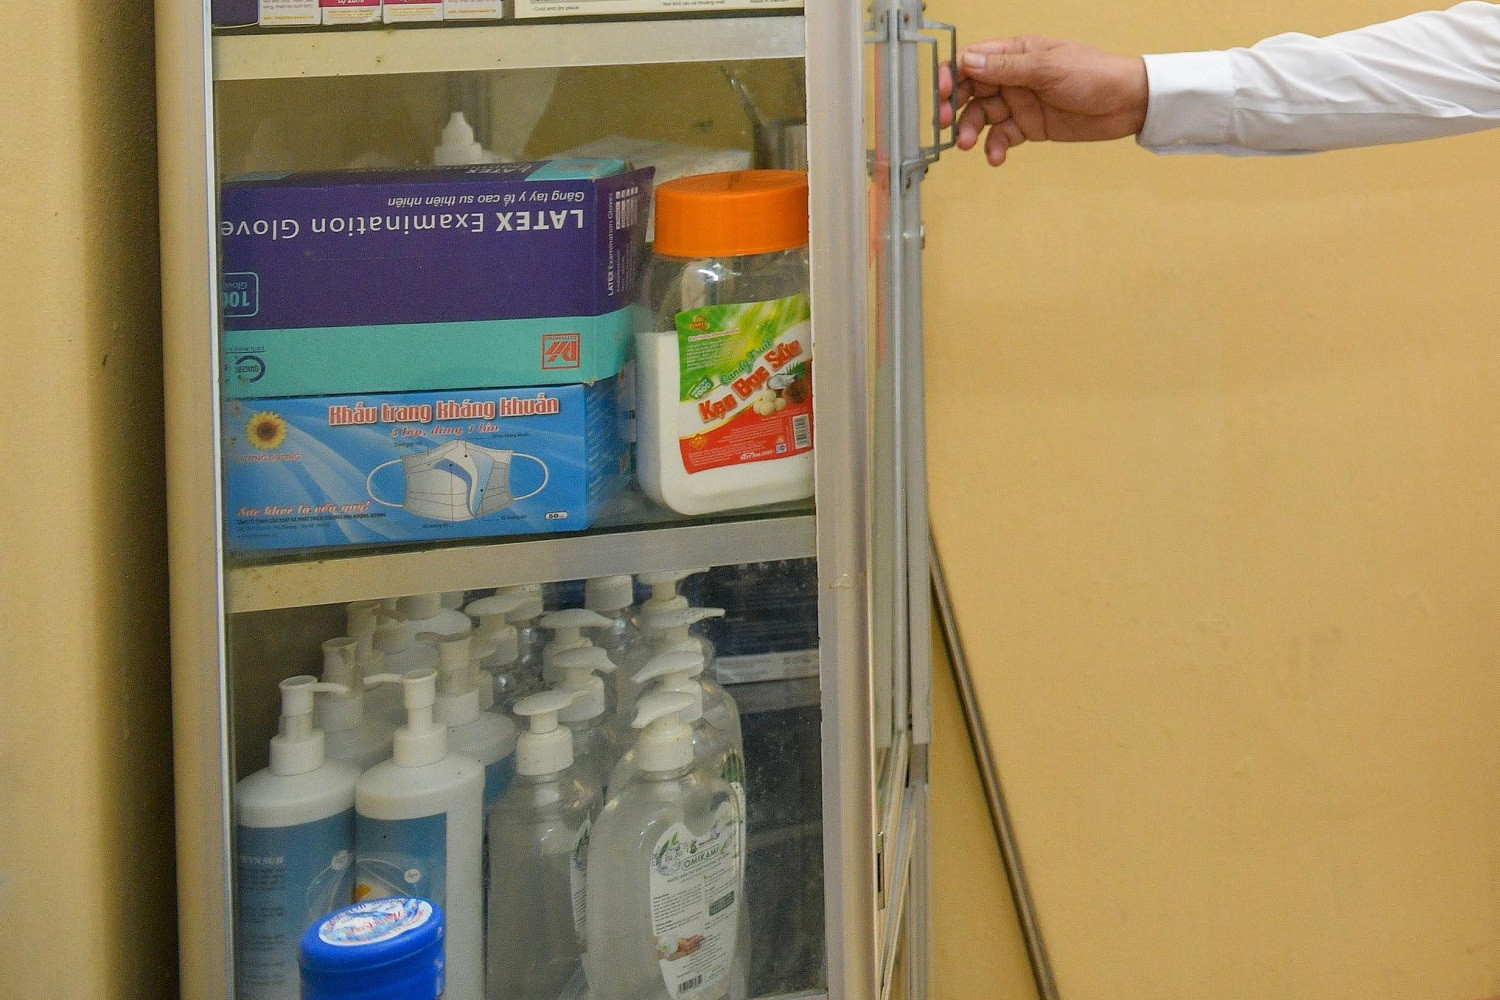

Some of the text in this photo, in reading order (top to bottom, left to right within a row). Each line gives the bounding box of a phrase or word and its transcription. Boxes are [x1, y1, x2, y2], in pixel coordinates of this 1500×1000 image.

[387, 190, 585, 208] Găng tay y tế cao su thiên nhiên
[311, 211, 484, 239] Examination
[496, 209, 584, 231] LATEX
[720, 339, 772, 386] Candy Fruit
[329, 393, 560, 426] Khẩu trang kháng khuẩn
[683, 847, 719, 868] OMIKAMI
